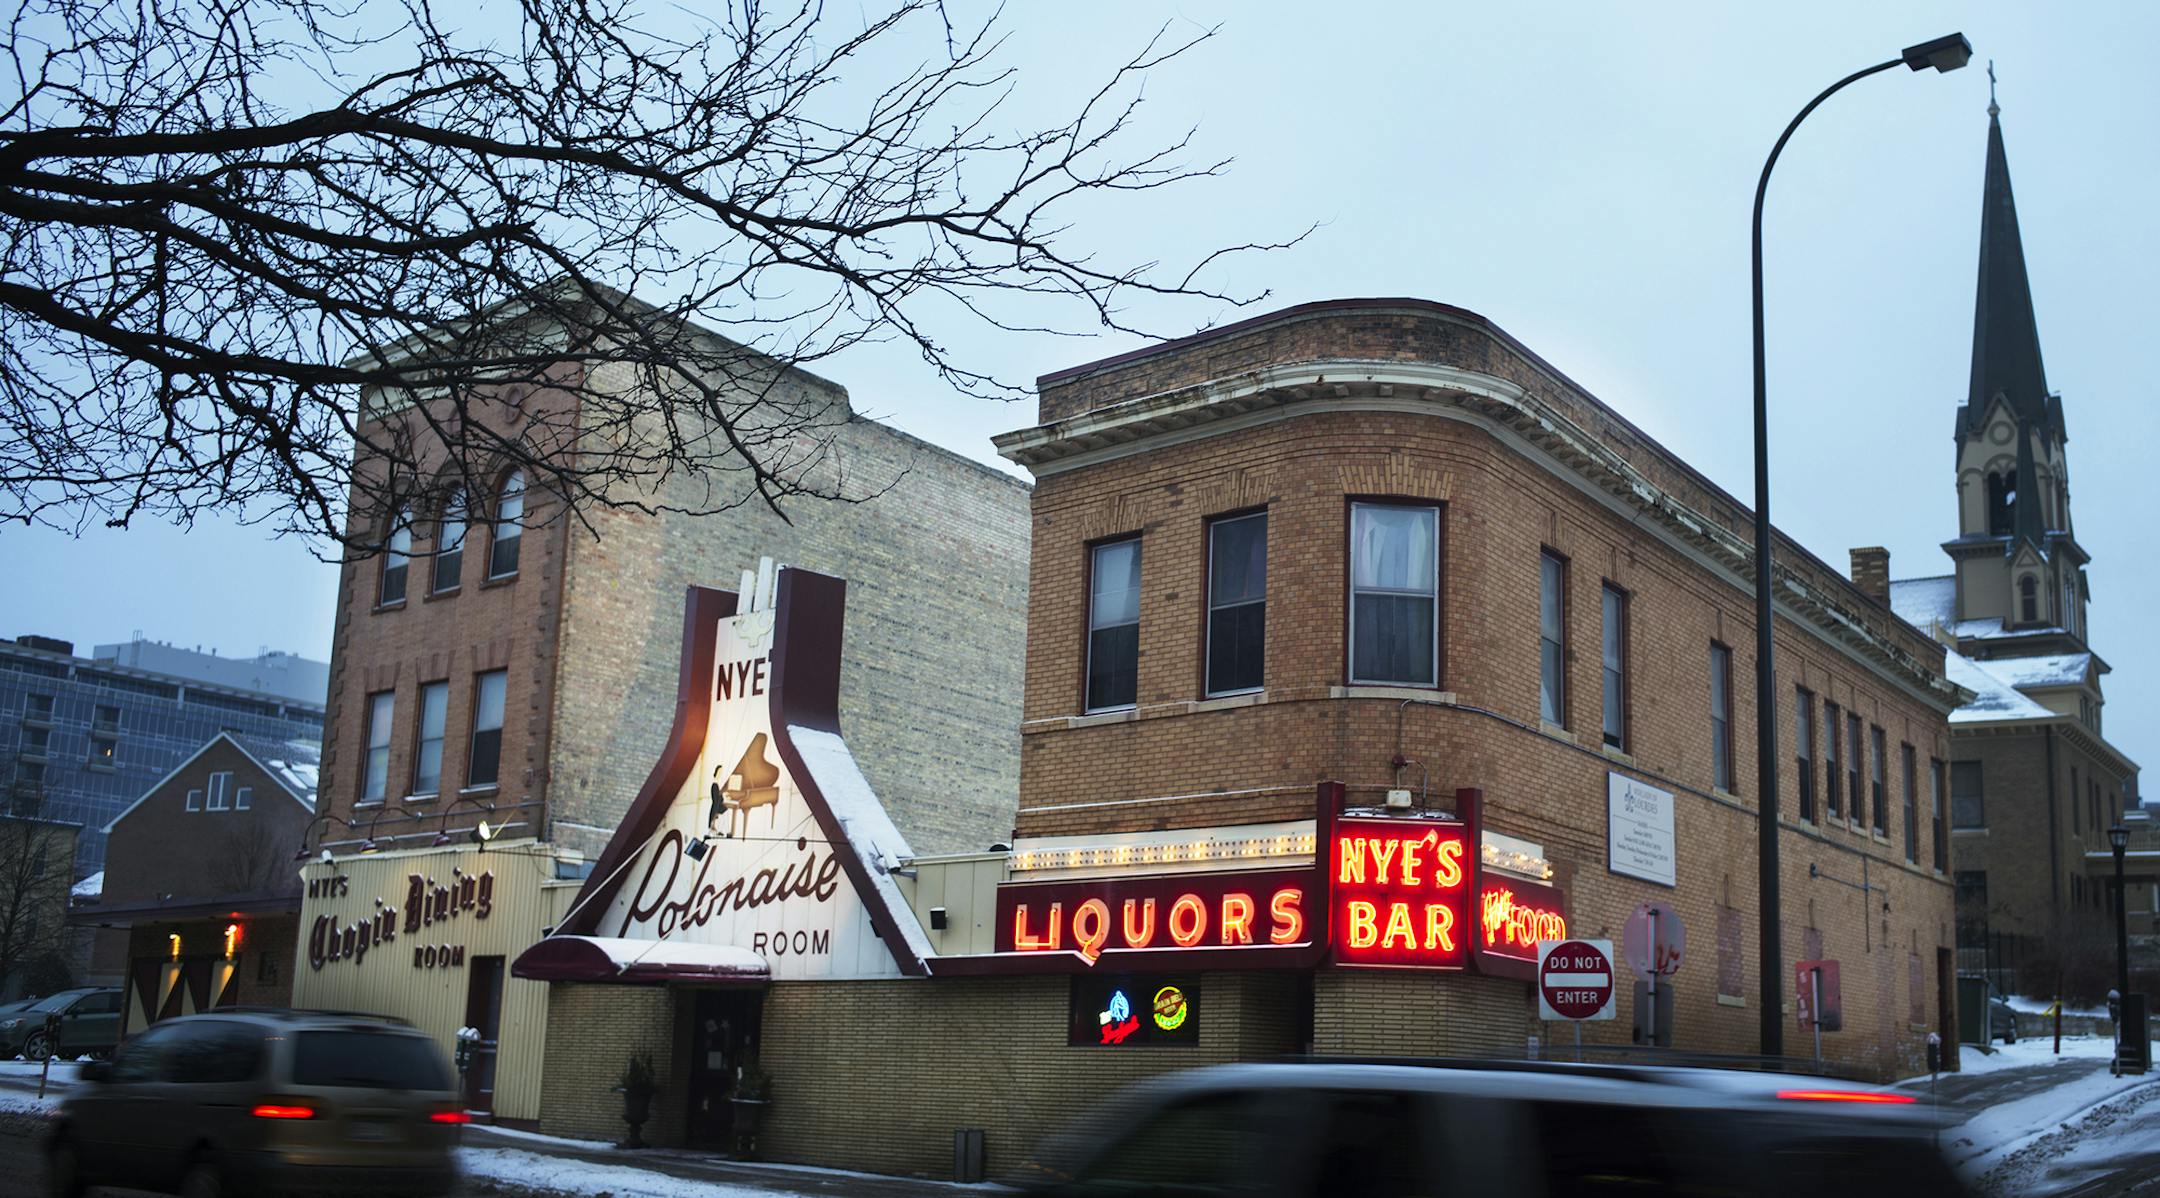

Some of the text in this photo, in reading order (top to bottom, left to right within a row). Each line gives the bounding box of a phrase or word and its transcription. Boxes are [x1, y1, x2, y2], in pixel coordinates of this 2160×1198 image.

[1339, 828, 1463, 888] NYE'S
[617, 828, 841, 940] Polonaise
[309, 867, 494, 972] Chopin Dining
[753, 929, 830, 956] ROOM
[1014, 888, 1303, 960] LIQUORS
[1347, 901, 1455, 952] BAR
[1505, 903, 1567, 948] FOOD
[414, 943, 464, 969] ROOM
[1550, 956, 1601, 969] DO NOT
[1556, 991, 1598, 1004] ENTER
